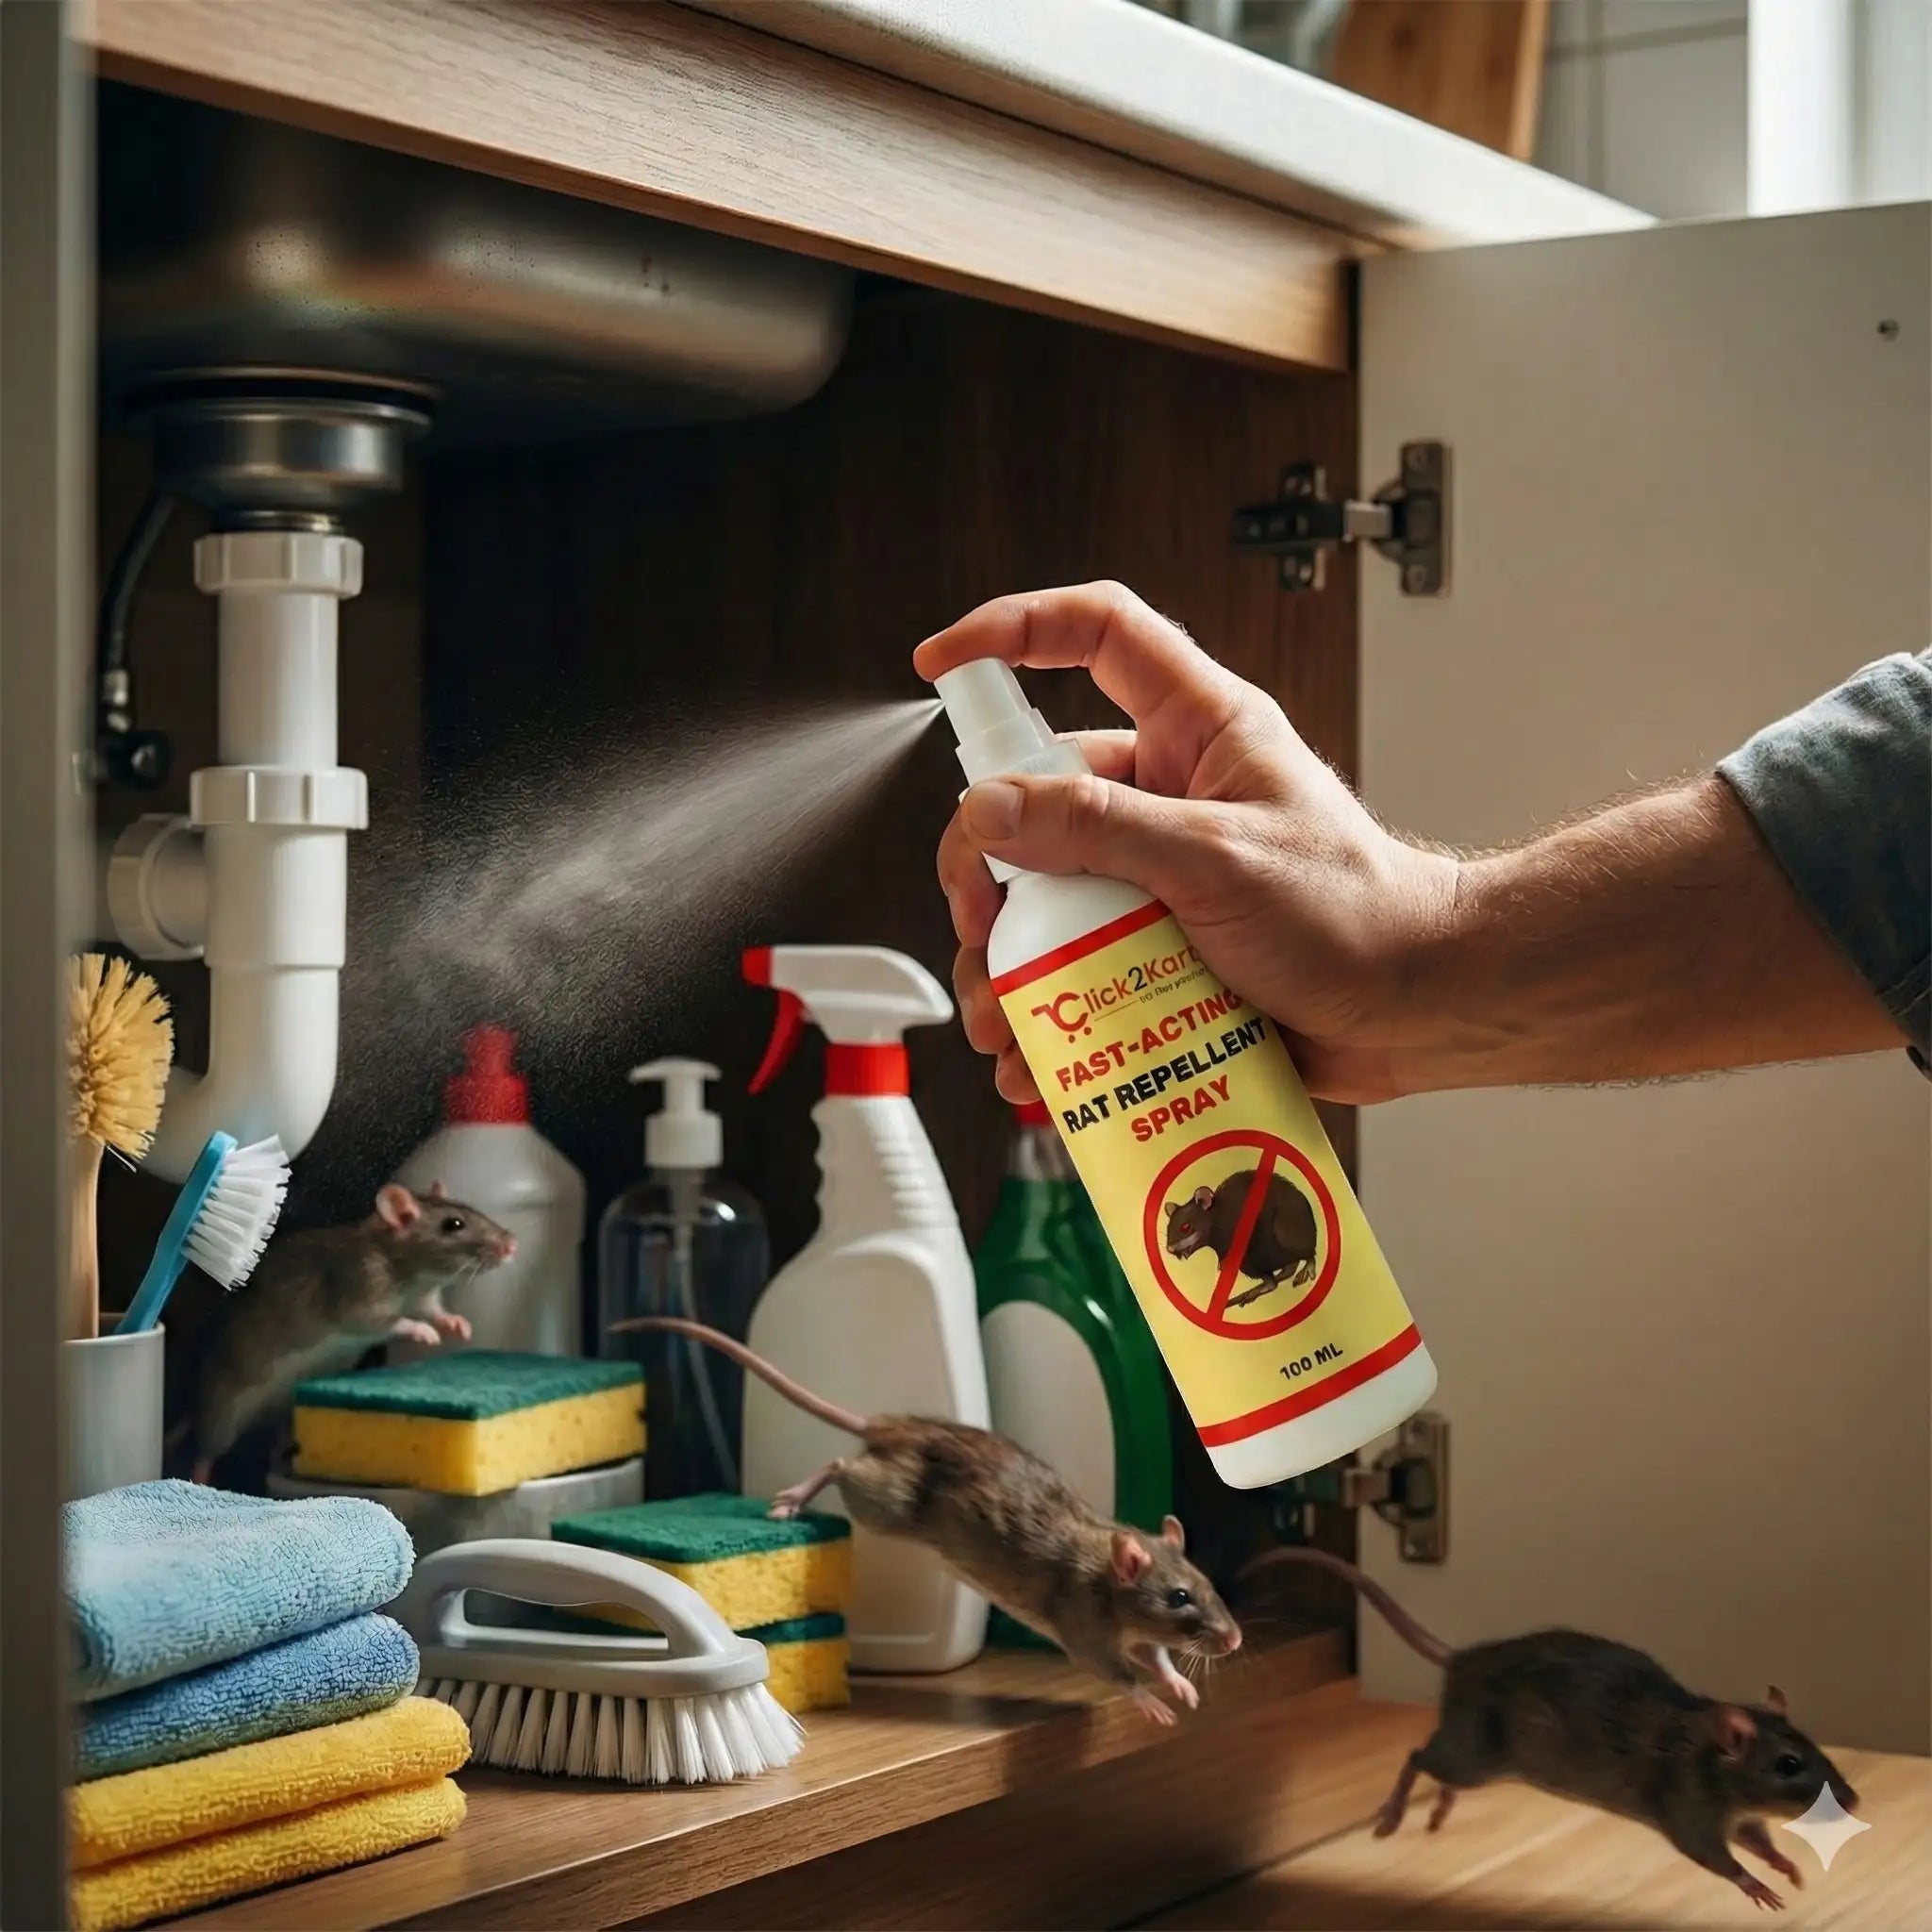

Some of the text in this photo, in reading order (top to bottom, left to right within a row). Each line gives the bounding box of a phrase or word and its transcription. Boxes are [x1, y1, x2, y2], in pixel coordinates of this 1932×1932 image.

[1056, 987, 1242, 1091] FAST-ACTING
[1062, 1017, 1267, 1133] RAT REPELLENT
[1131, 1074, 1230, 1141] SPRAY
[1279, 1342, 1343, 1380] 100 ML
